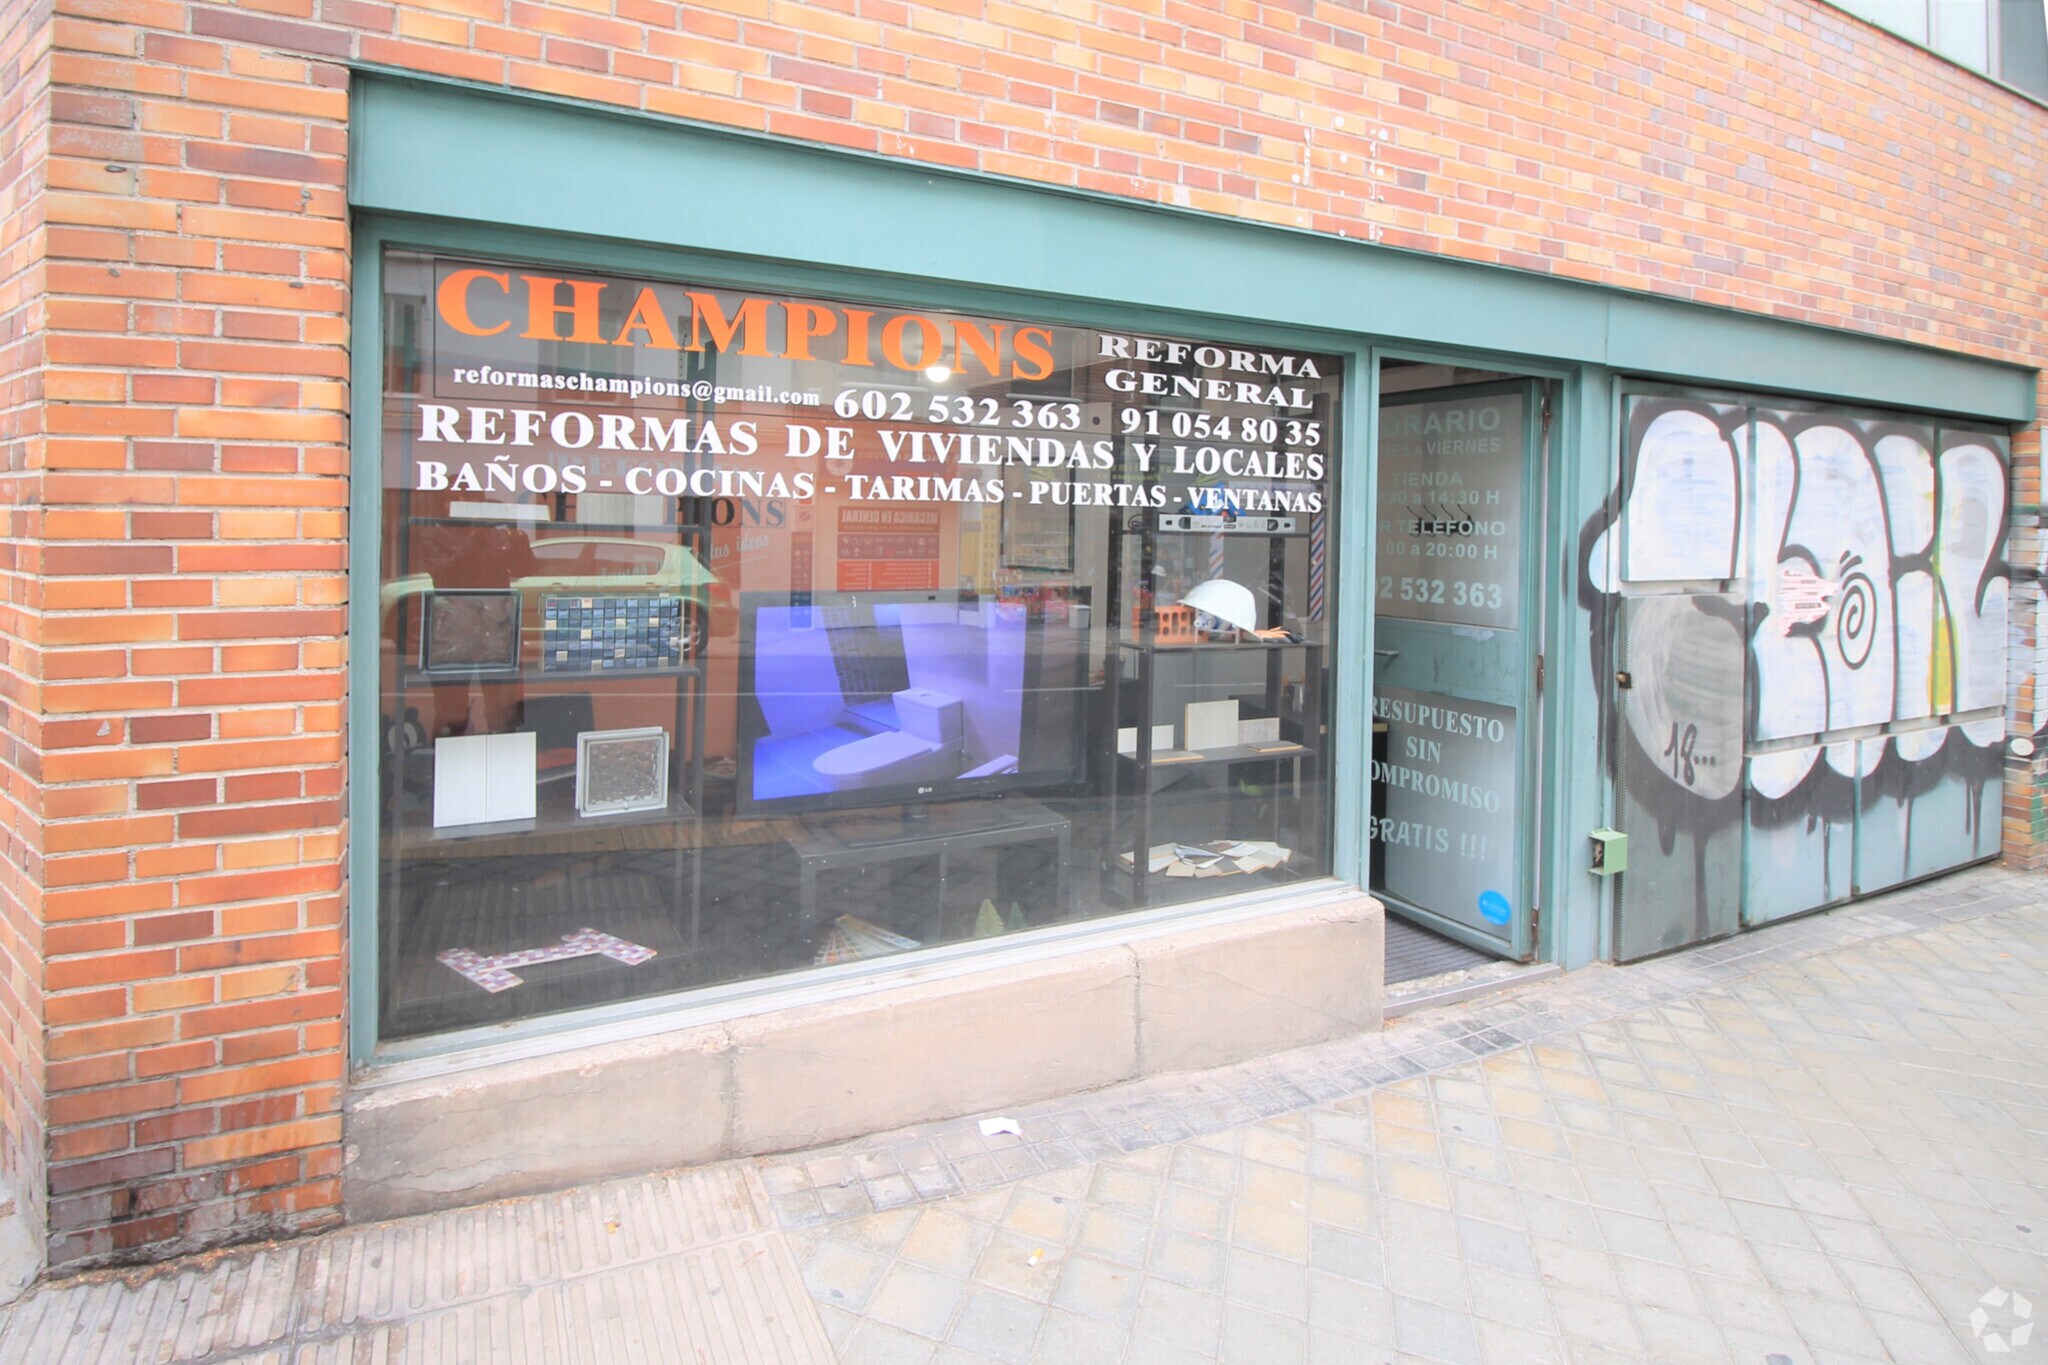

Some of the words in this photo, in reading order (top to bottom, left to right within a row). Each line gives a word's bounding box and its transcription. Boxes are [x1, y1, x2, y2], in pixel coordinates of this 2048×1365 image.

[436, 268, 1055, 381] CHAMPIONS
[1098, 334, 1322, 380] REFORMA
[453, 366, 821, 407] reformaschampions@gmail.com
[1105, 368, 1314, 410] GENERAL
[834, 387, 914, 422] 602
[927, 394, 1001, 427] 532
[1011, 399, 1081, 430] 363
[1120, 408, 1161, 437] 91
[1171, 411, 1231, 440] 054
[1240, 415, 1278, 444] 80
[1284, 419, 1322, 447] 35
[1382, 407, 1500, 438] ORARIO
[417, 403, 758, 457] REFORMAS
[784, 424, 855, 460] DE
[877, 430, 1114, 471] VIVIENDAS
[1131, 443, 1157, 473] Y
[1173, 445, 1325, 481] LOCALES
[1426, 438, 1500, 455] VIERNES
[415, 454, 587, 495] BAÑOS
[624, 467, 815, 500] COCINAS
[845, 474, 1005, 504] TARIMAS
[1029, 481, 1167, 509] PUERTAS
[1187, 487, 1323, 514] VENTANAS
[1391, 471, 1464, 487] TIENDA
[1412, 493, 1422, 505] a
[1428, 490, 1480, 505] 14:30
[1486, 490, 1500, 505] H
[1410, 544, 1421, 556] a
[1425, 542, 1478, 558] 20:00
[1484, 545, 1498, 560] H
[1400, 577, 1446, 605] 532
[1453, 581, 1503, 610] 363
[1372, 695, 1505, 743] RESUPUESTO
[1406, 735, 1442, 764] SIN
[1370, 759, 1501, 814] OMPROMISO
[1369, 815, 1450, 853] GRATIS
[1460, 832, 1487, 861] !!!
